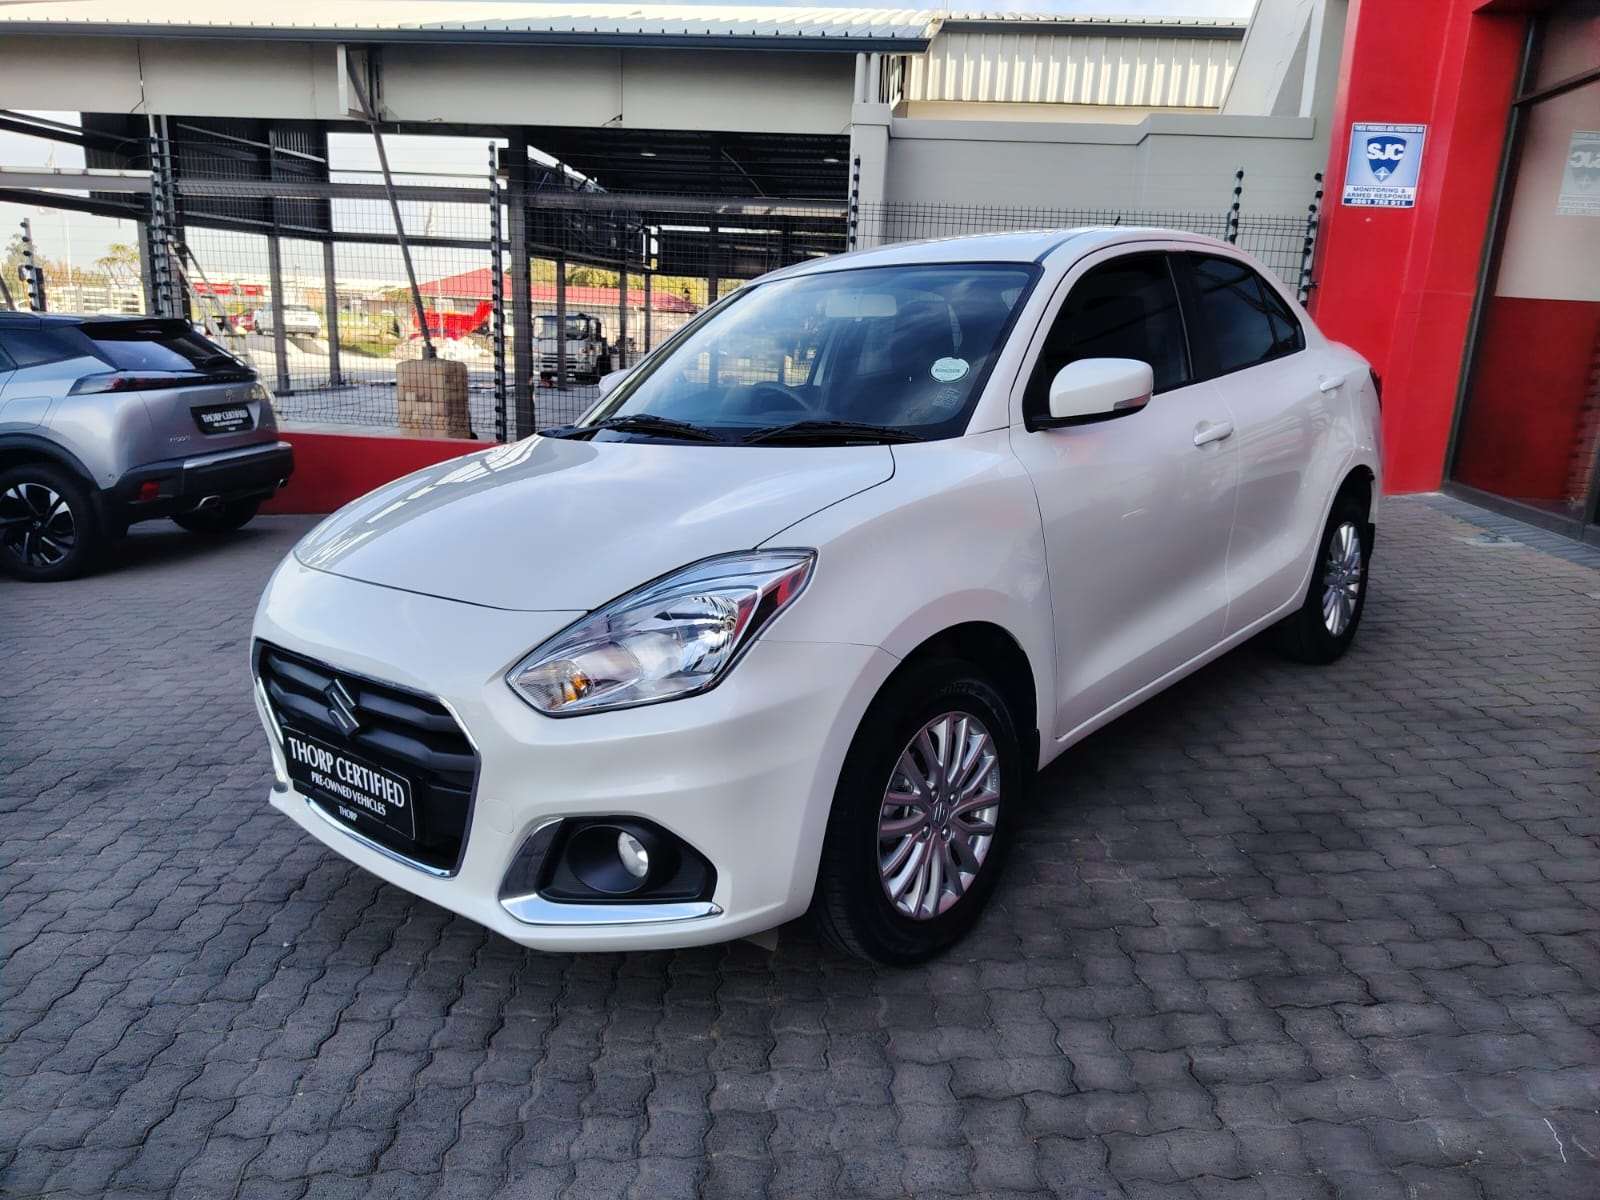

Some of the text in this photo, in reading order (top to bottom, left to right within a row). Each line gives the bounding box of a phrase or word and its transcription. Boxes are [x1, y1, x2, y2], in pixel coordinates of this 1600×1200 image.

[1367, 143, 1404, 160] SJC
[288, 737, 405, 808] THORP CERTIFIED
[311, 771, 386, 816] PRE-OWNED VEHICLES
[339, 806, 358, 821] THORP
